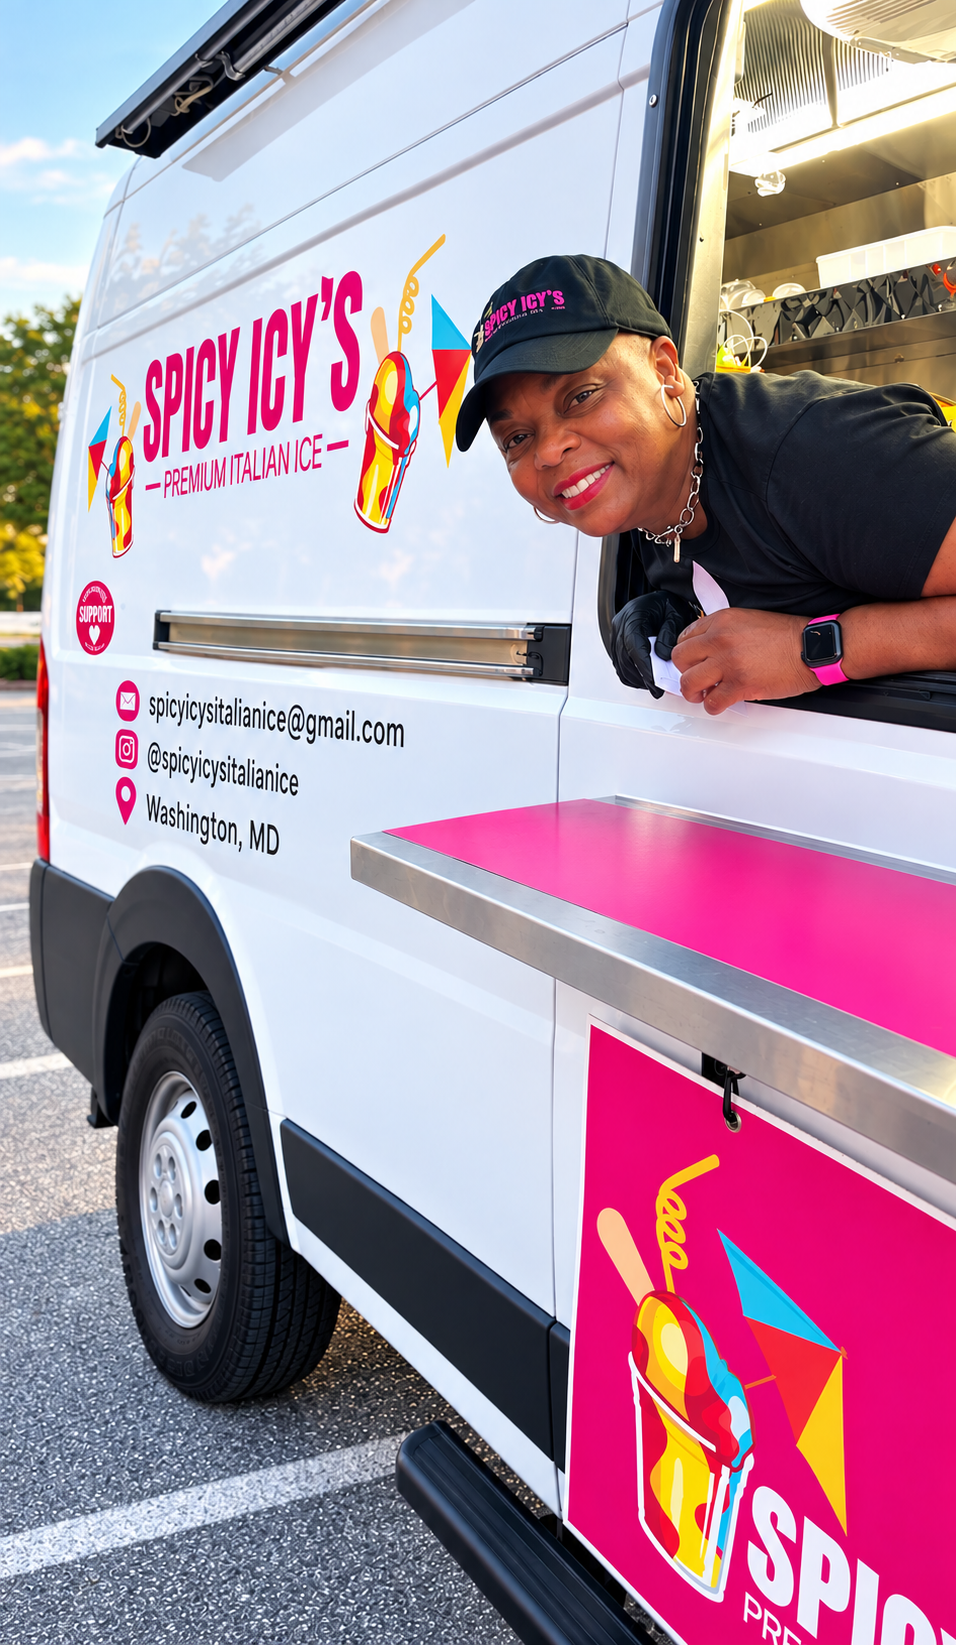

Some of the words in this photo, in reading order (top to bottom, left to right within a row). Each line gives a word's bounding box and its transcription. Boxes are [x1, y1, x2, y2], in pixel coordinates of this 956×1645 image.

[484, 299, 517, 337] SPICY
[520, 289, 565, 312] ICY'S
[143, 326, 241, 463] SPICY
[246, 270, 364, 436] ICY'S
[163, 456, 227, 499] PREMIUM
[229, 441, 291, 486] ITALIAN
[294, 433, 323, 473] ICE
[79, 605, 113, 623] SUPPORT
[149, 690, 405, 748] spicyicysitalianice@gmail.com
[147, 741, 299, 797] @spicyicysitalianice
[146, 793, 243, 853] Washington,
[249, 819, 280, 856] MD
[747, 1486, 956, 1645] SPI
